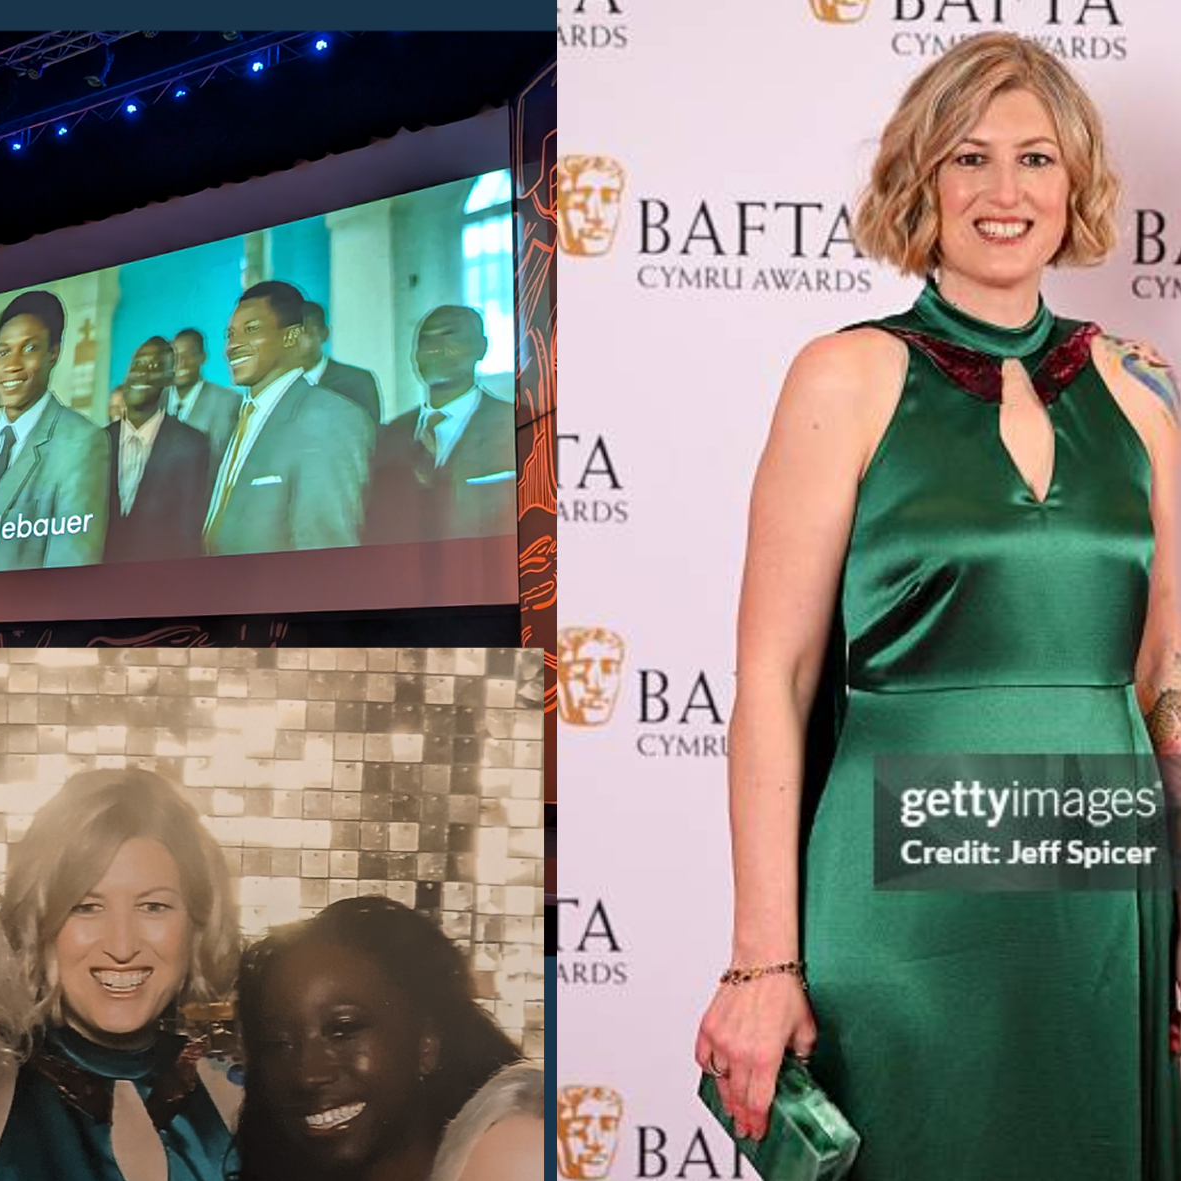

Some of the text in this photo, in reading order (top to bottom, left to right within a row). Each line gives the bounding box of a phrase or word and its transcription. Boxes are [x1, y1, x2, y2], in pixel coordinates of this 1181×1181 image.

[891, 32, 1127, 60] CYM ARDS
[638, 198, 868, 258] BAFTA
[637, 265, 872, 293] CYMRU AWARDS
[637, 669, 736, 724] BA
